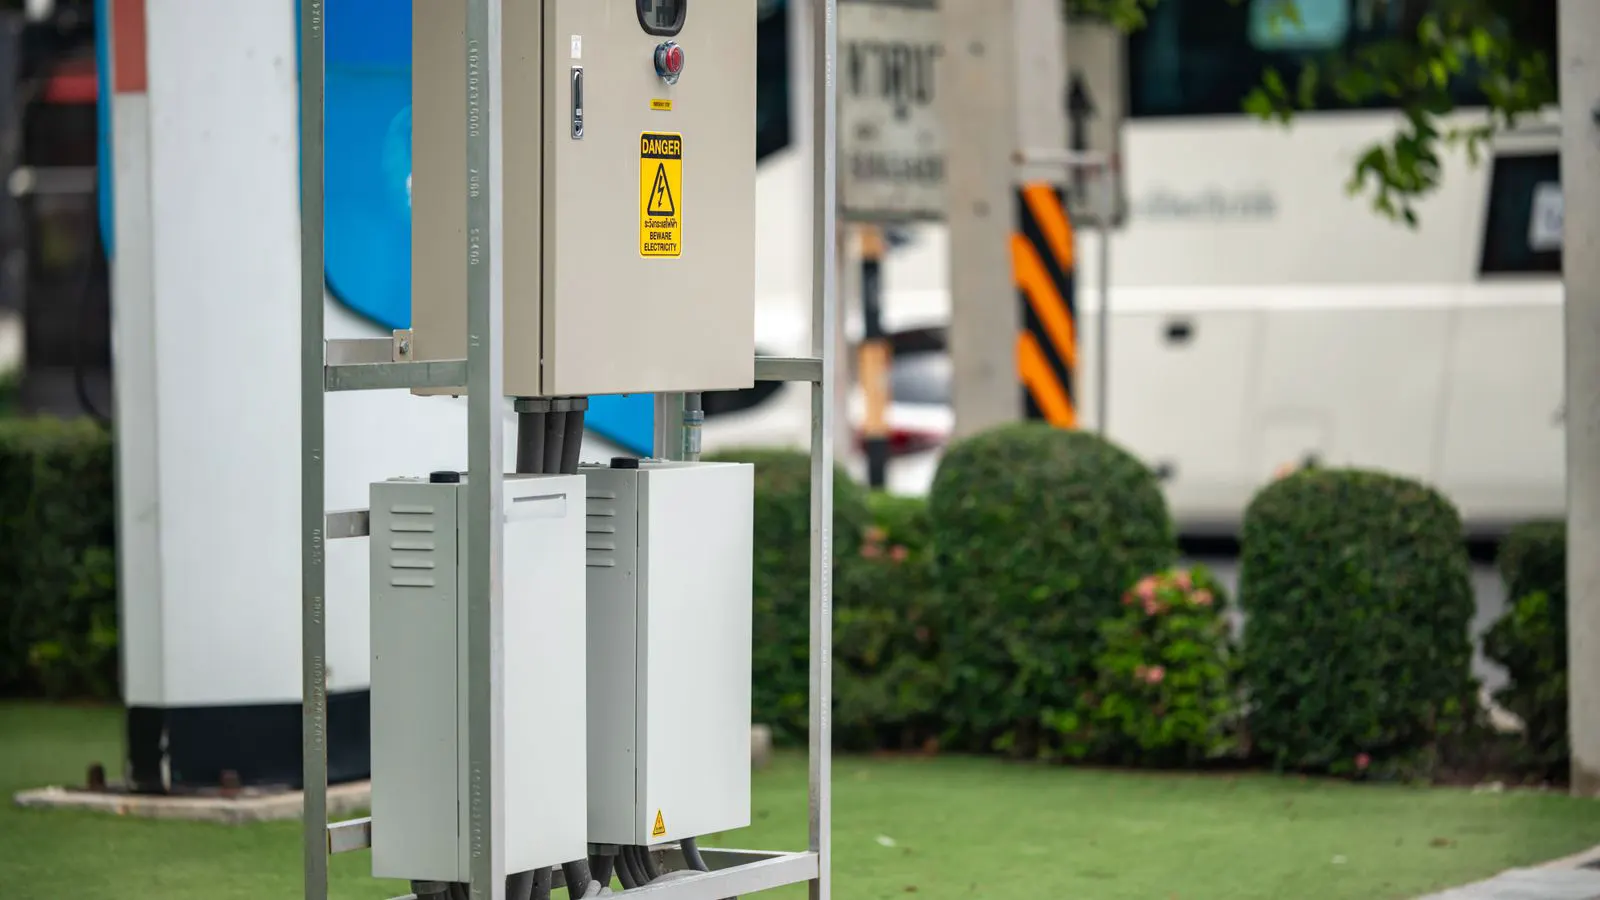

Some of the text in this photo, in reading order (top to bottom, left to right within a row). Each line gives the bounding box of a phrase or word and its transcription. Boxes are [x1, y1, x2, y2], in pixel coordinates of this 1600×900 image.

[642, 138, 680, 155] DANGER
[649, 231, 672, 241] BEWARE
[644, 242, 677, 252] ELECTRICITY
